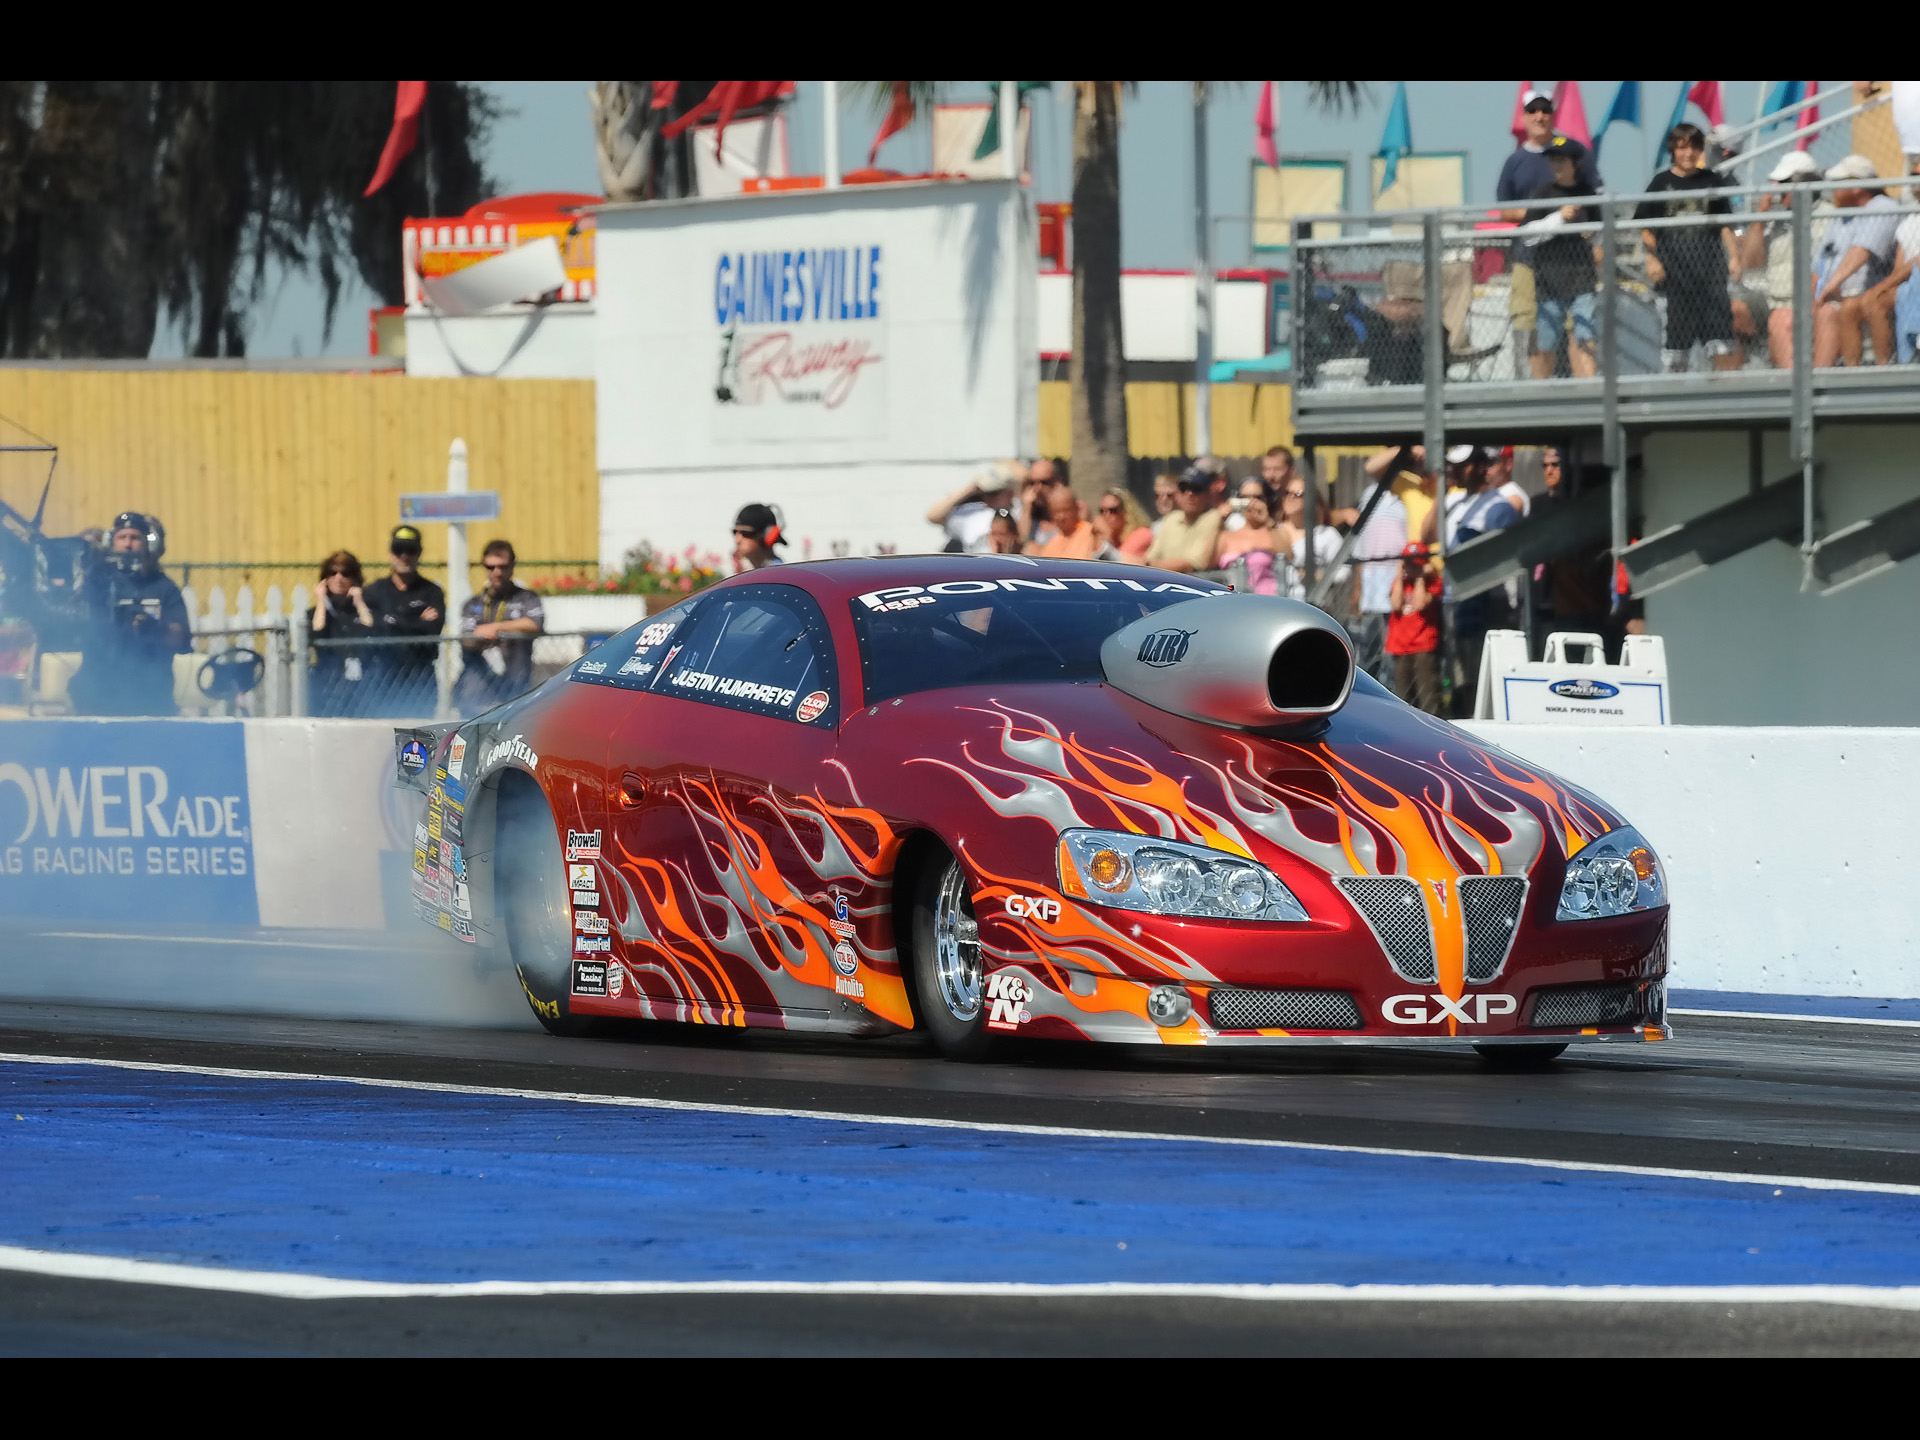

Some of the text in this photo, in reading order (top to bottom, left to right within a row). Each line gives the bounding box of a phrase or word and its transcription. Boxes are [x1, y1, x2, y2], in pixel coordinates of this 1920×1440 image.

[715, 246, 880, 324] GAINESVILLE
[635, 623, 676, 646] 1568
[1136, 629, 1199, 662] DART
[672, 669, 797, 707] JUSTIN HUMPHREYS
[803, 697, 827, 710] OLSON
[568, 831, 601, 848] Browell
[34, 846, 135, 876] RACING
[146, 846, 247, 876] SERIES
[571, 879, 594, 889] IMPACT
[576, 911, 592, 919] ROYAL
[1005, 894, 1061, 921] GXP
[830, 919, 856, 934] GOODRIDGE
[575, 936, 611, 955] MagnaFuel
[578, 963, 605, 974] American
[580, 972, 604, 987] Racing
[836, 976, 864, 998] Autolite
[1381, 994, 1517, 1025] GXP
